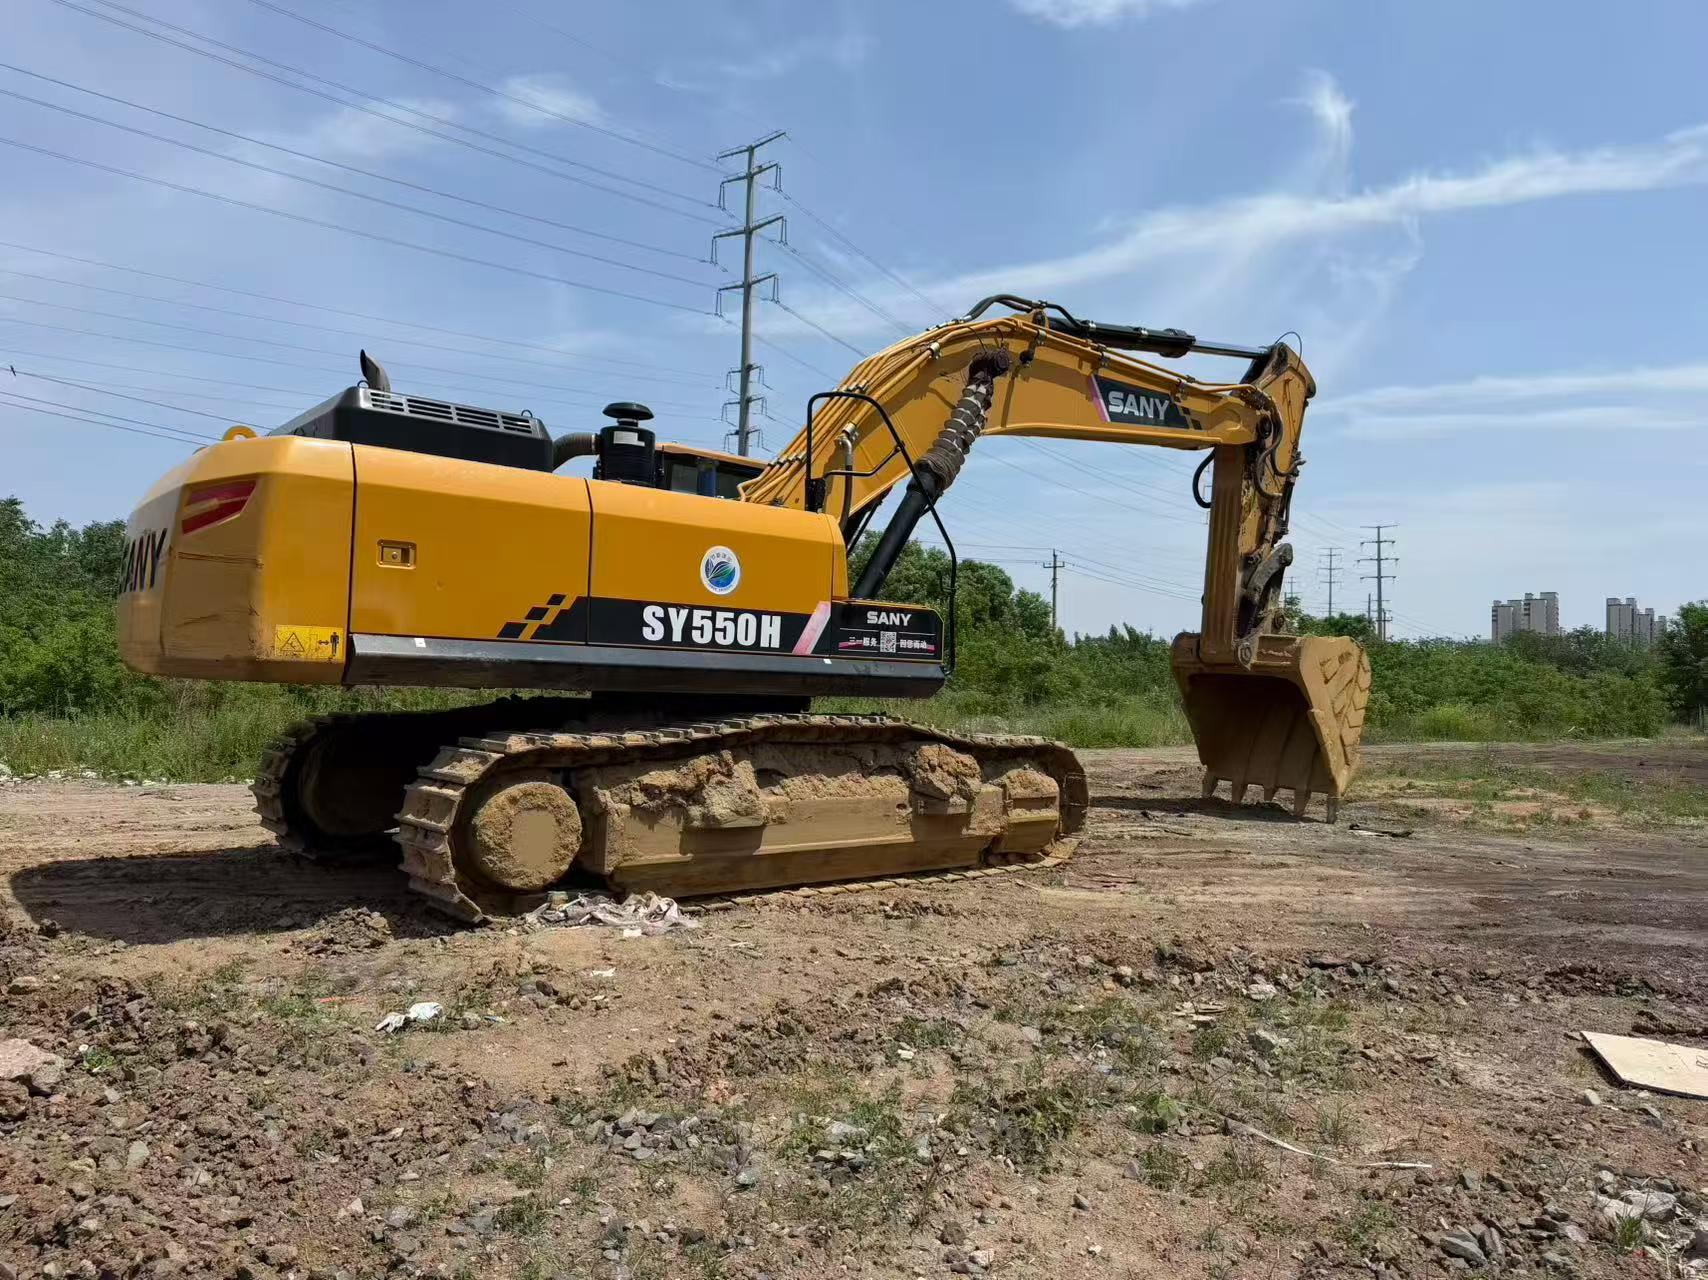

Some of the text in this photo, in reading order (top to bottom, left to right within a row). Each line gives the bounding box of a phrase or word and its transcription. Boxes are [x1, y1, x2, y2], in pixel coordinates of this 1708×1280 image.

[1108, 390, 1170, 420] SANY
[641, 605, 782, 649] SY550H
[866, 611, 912, 627] SANY
[848, 636, 878, 647] 三一服务
